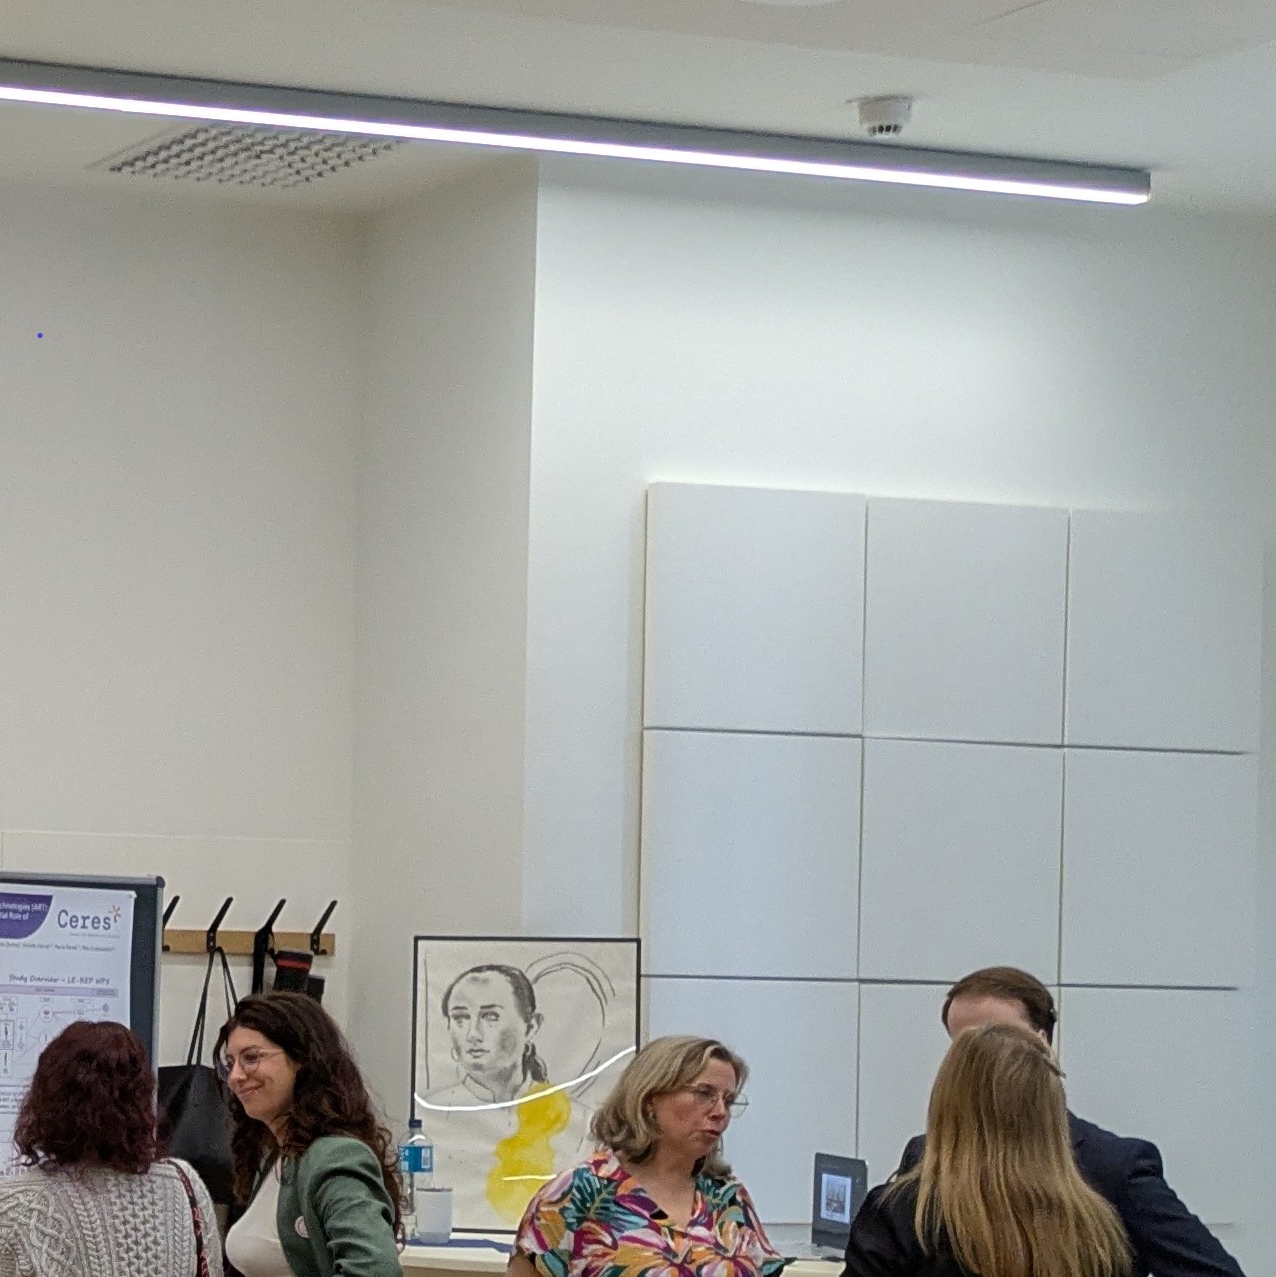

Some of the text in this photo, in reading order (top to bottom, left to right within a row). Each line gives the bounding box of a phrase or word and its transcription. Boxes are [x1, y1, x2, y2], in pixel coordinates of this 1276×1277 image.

[9, 911, 23, 920] Role
[23, 912, 30, 921] of
[57, 909, 111, 931] Ceres
[9, 975, 28, 984] Study
[30, 975, 60, 984] Overview
